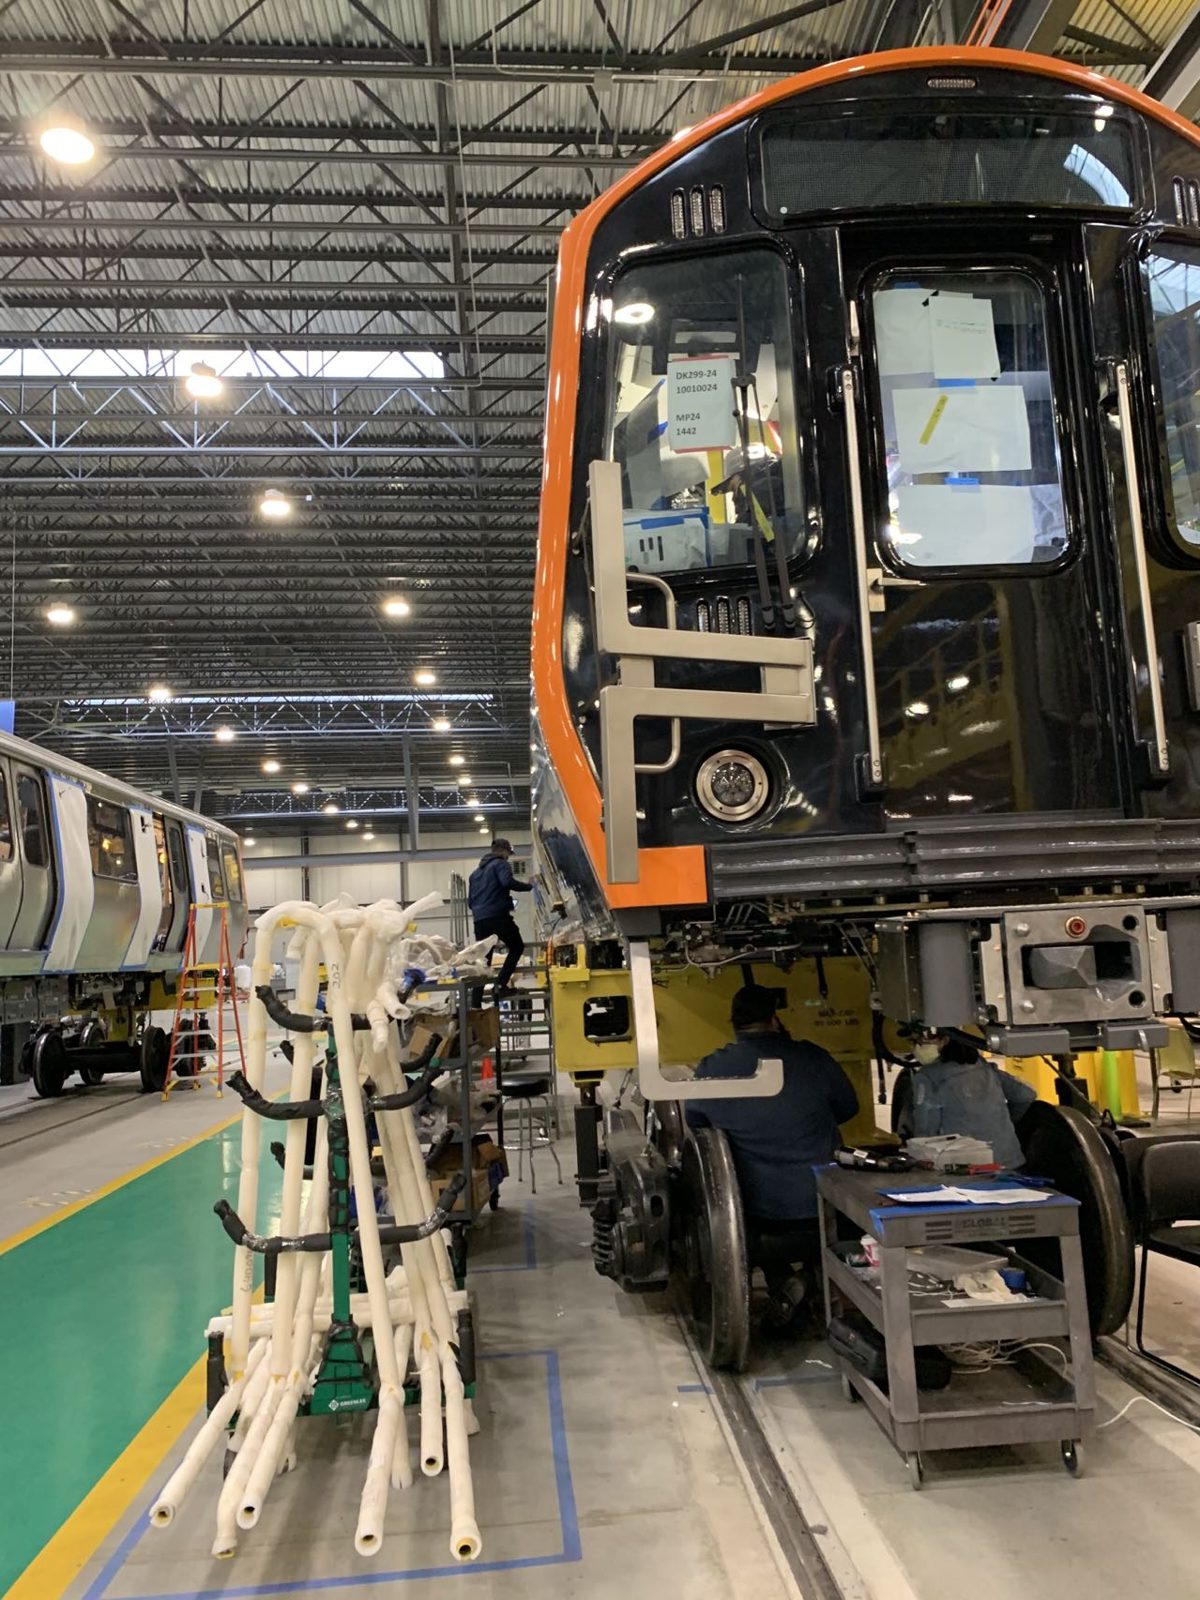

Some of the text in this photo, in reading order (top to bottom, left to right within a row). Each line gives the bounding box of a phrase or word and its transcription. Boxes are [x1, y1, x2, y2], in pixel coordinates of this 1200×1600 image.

[676, 369, 717, 380] DK299-24
[676, 384, 718, 394] 10010024
[676, 413, 701, 422] MP24
[676, 427, 697, 436] 1442
